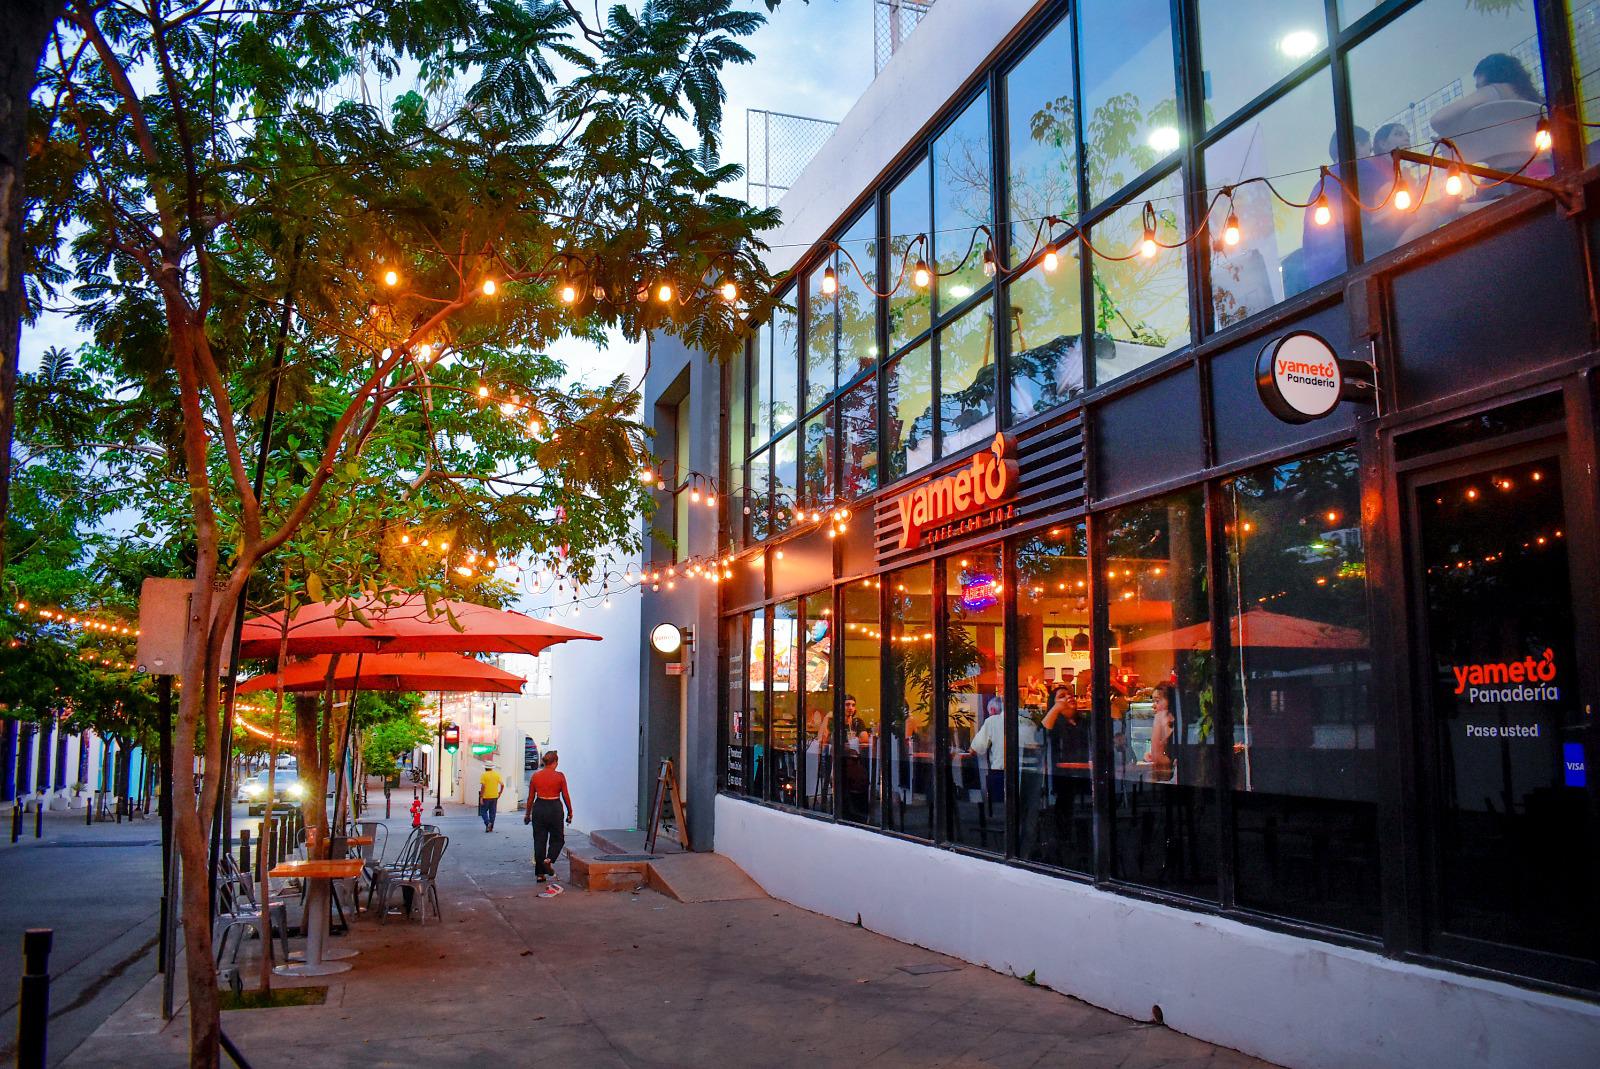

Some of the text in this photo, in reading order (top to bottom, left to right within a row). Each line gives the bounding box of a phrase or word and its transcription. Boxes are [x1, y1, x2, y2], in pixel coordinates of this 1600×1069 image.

[1287, 373, 1335, 388] Panadería
[1469, 683, 1559, 703] Panadería
[1466, 724, 1539, 737] Pase usted
[1566, 762, 1585, 771] VISA
